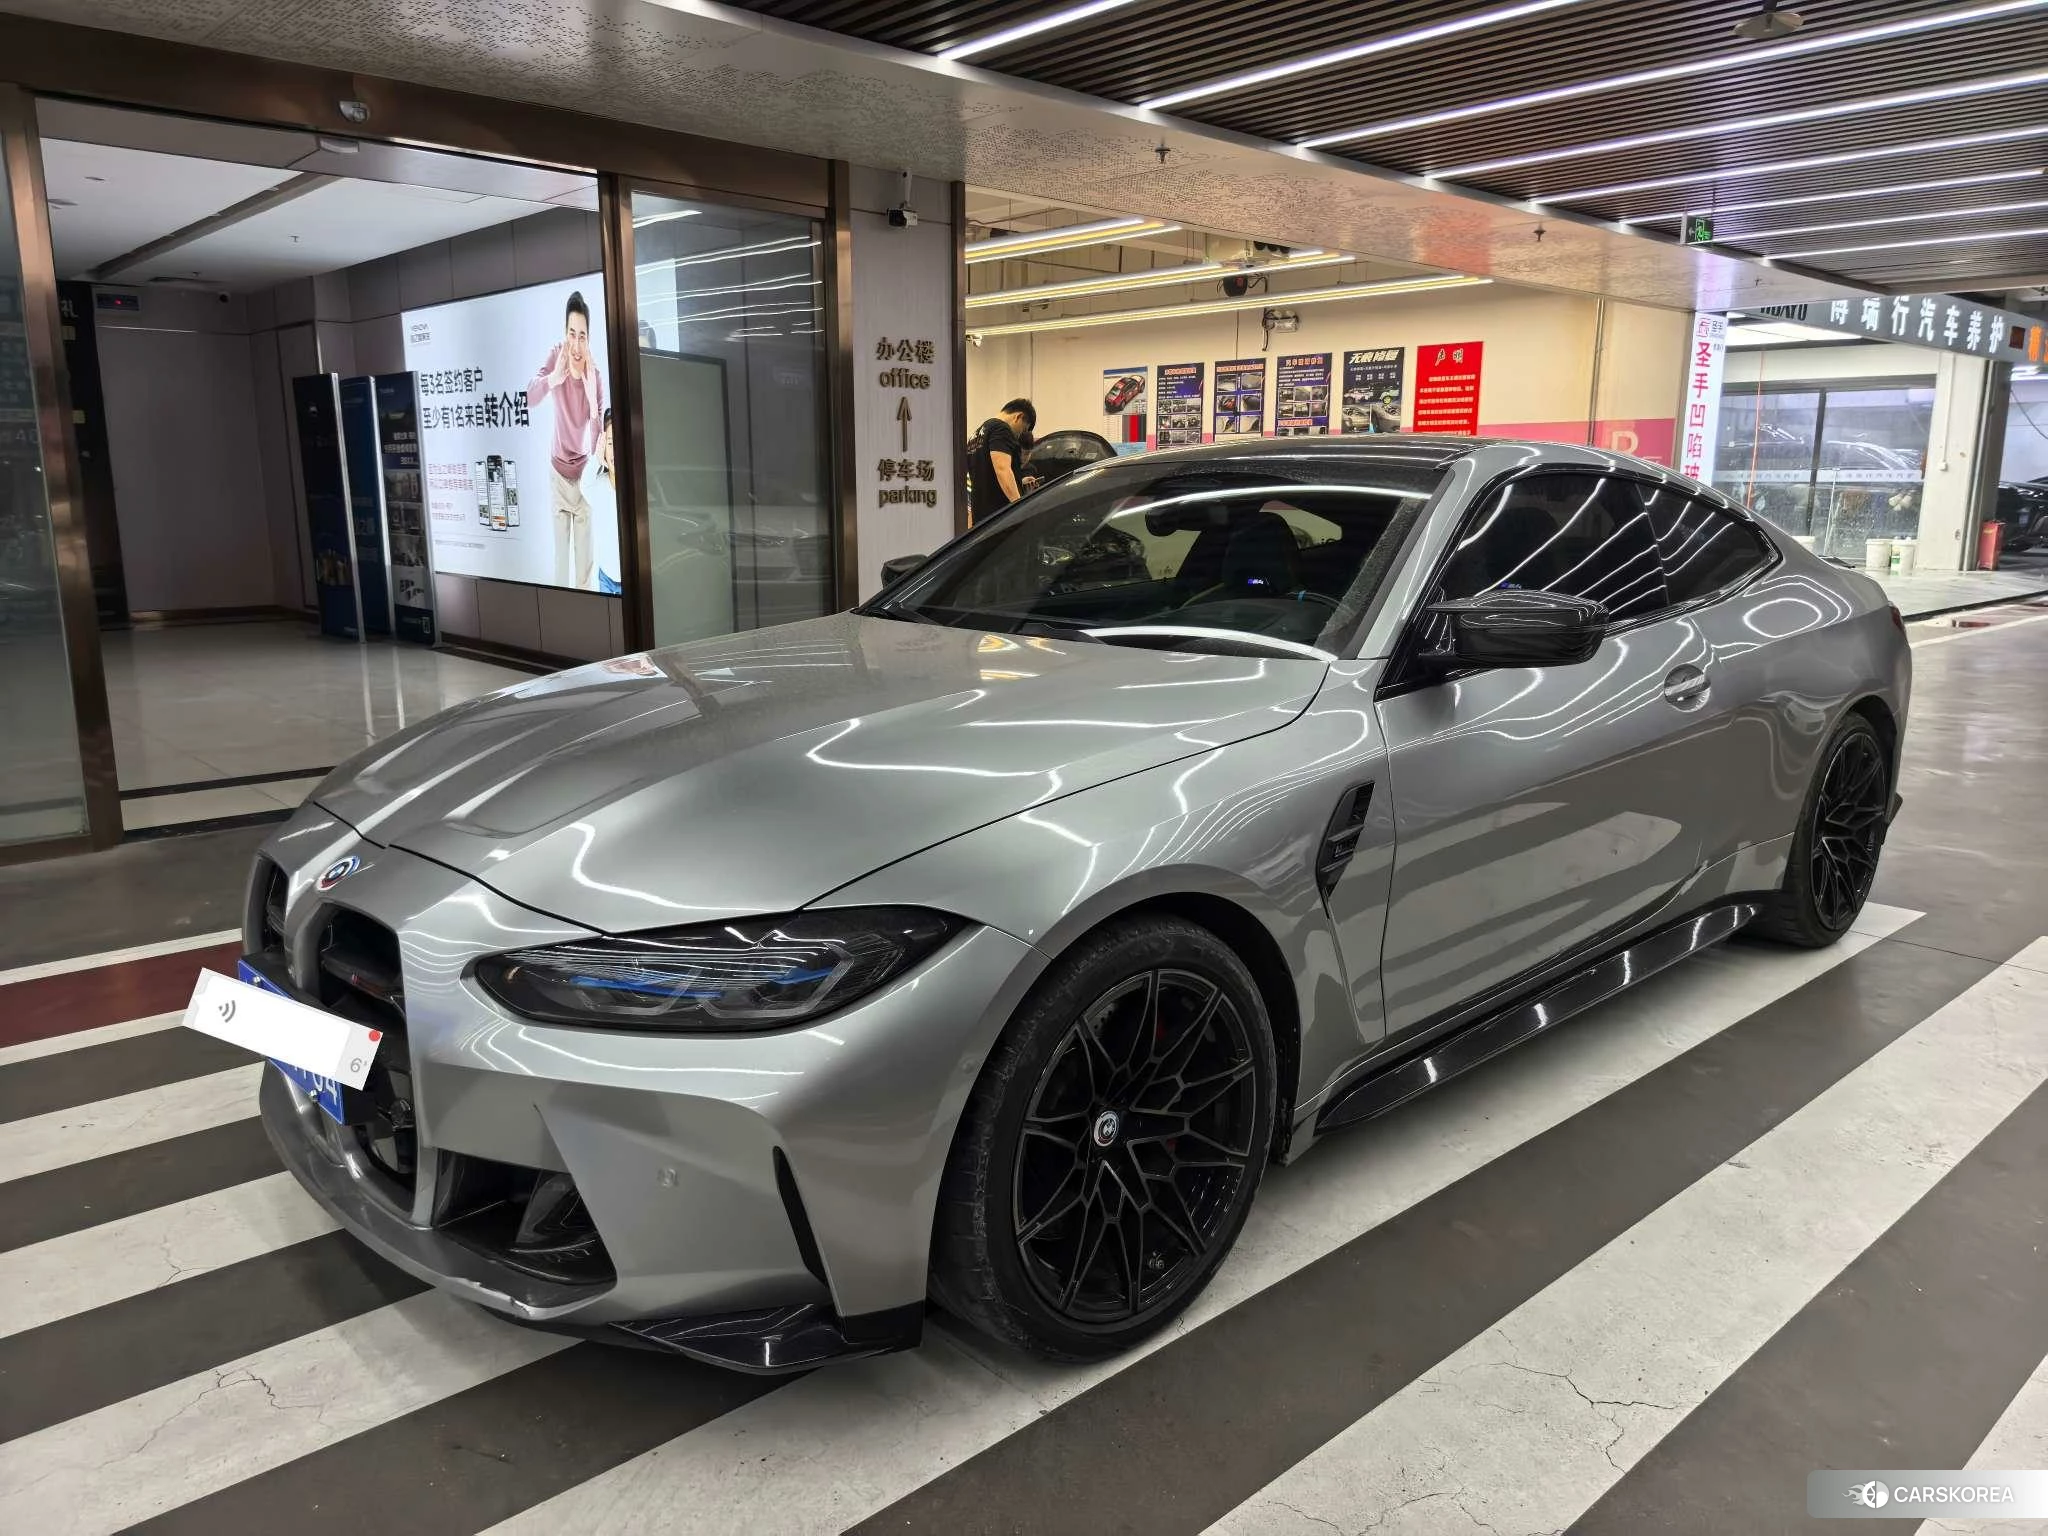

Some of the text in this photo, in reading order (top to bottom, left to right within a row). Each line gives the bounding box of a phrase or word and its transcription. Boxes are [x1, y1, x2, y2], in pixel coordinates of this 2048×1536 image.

[876, 337, 934, 364] 办公楼
[420, 366, 483, 397] 每3名签约客户
[879, 368, 930, 389] office
[422, 391, 530, 430] 至少有1名来自转介绍
[877, 459, 935, 482] 停车场
[878, 485, 937, 509] parking
